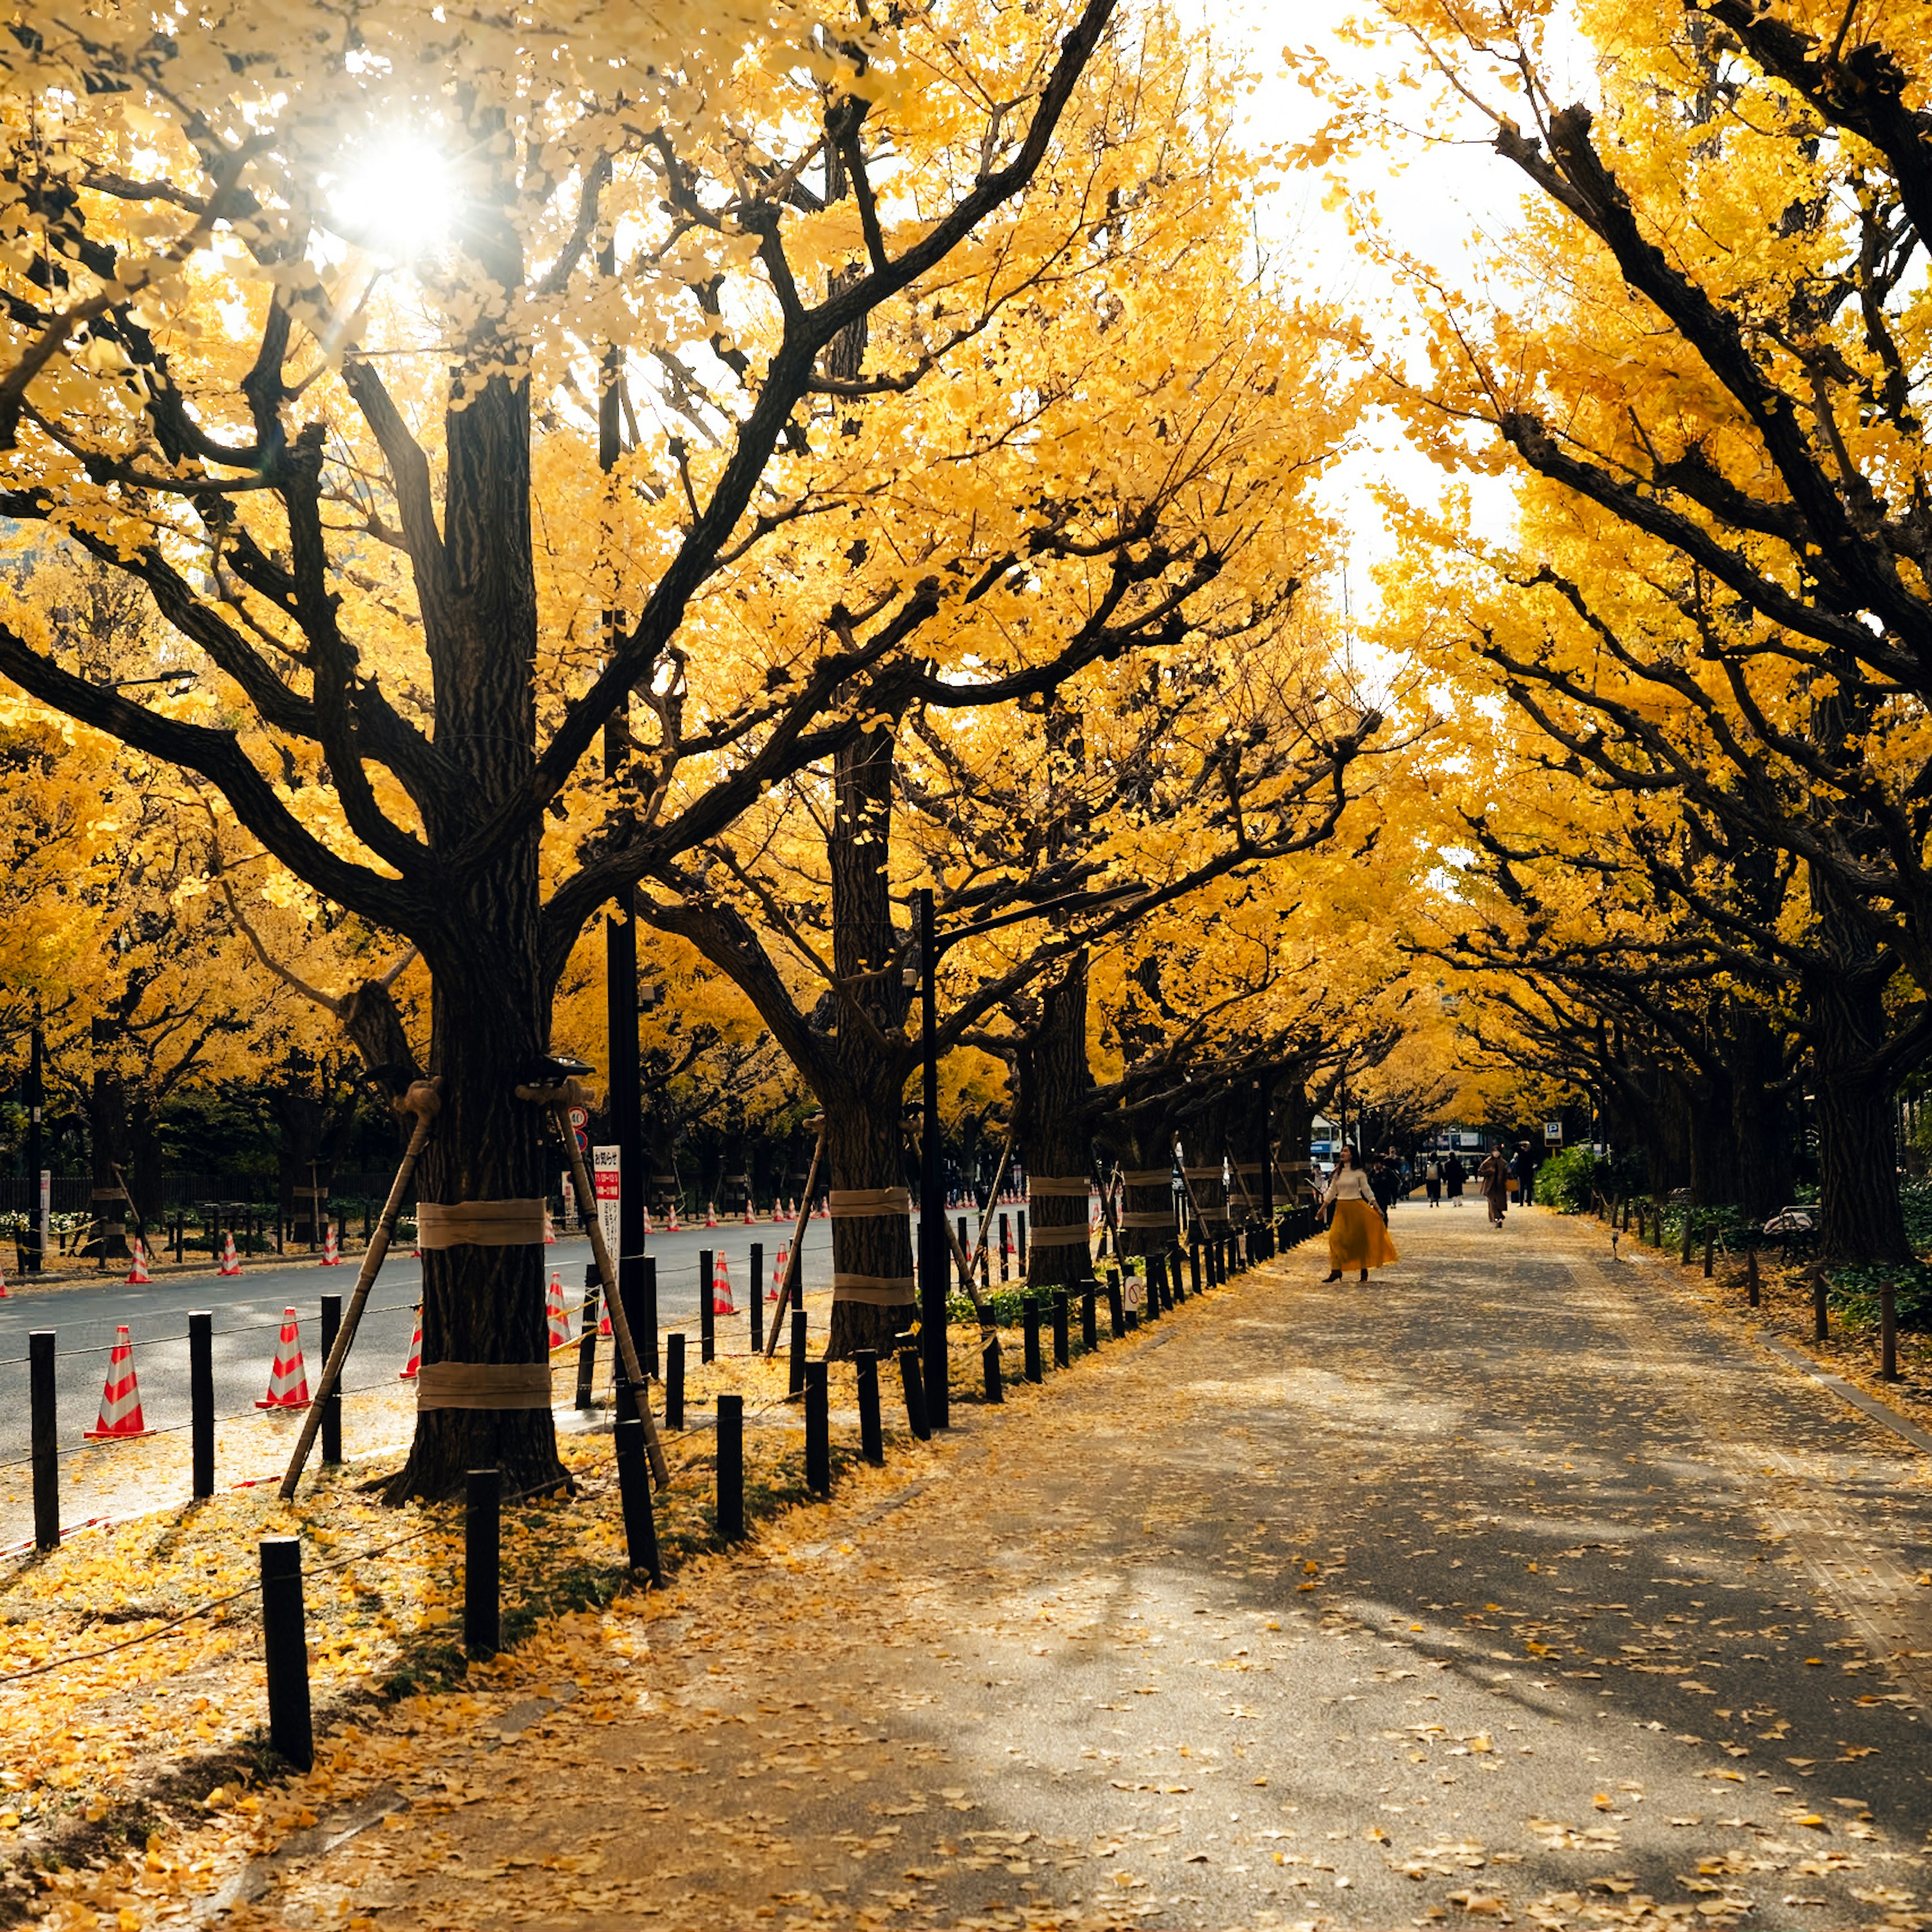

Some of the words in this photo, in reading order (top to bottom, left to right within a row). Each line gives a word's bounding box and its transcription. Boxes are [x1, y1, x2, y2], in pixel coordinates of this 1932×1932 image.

[572, 1113, 582, 1123] 40
[595, 1151, 617, 1166] お知らせ
